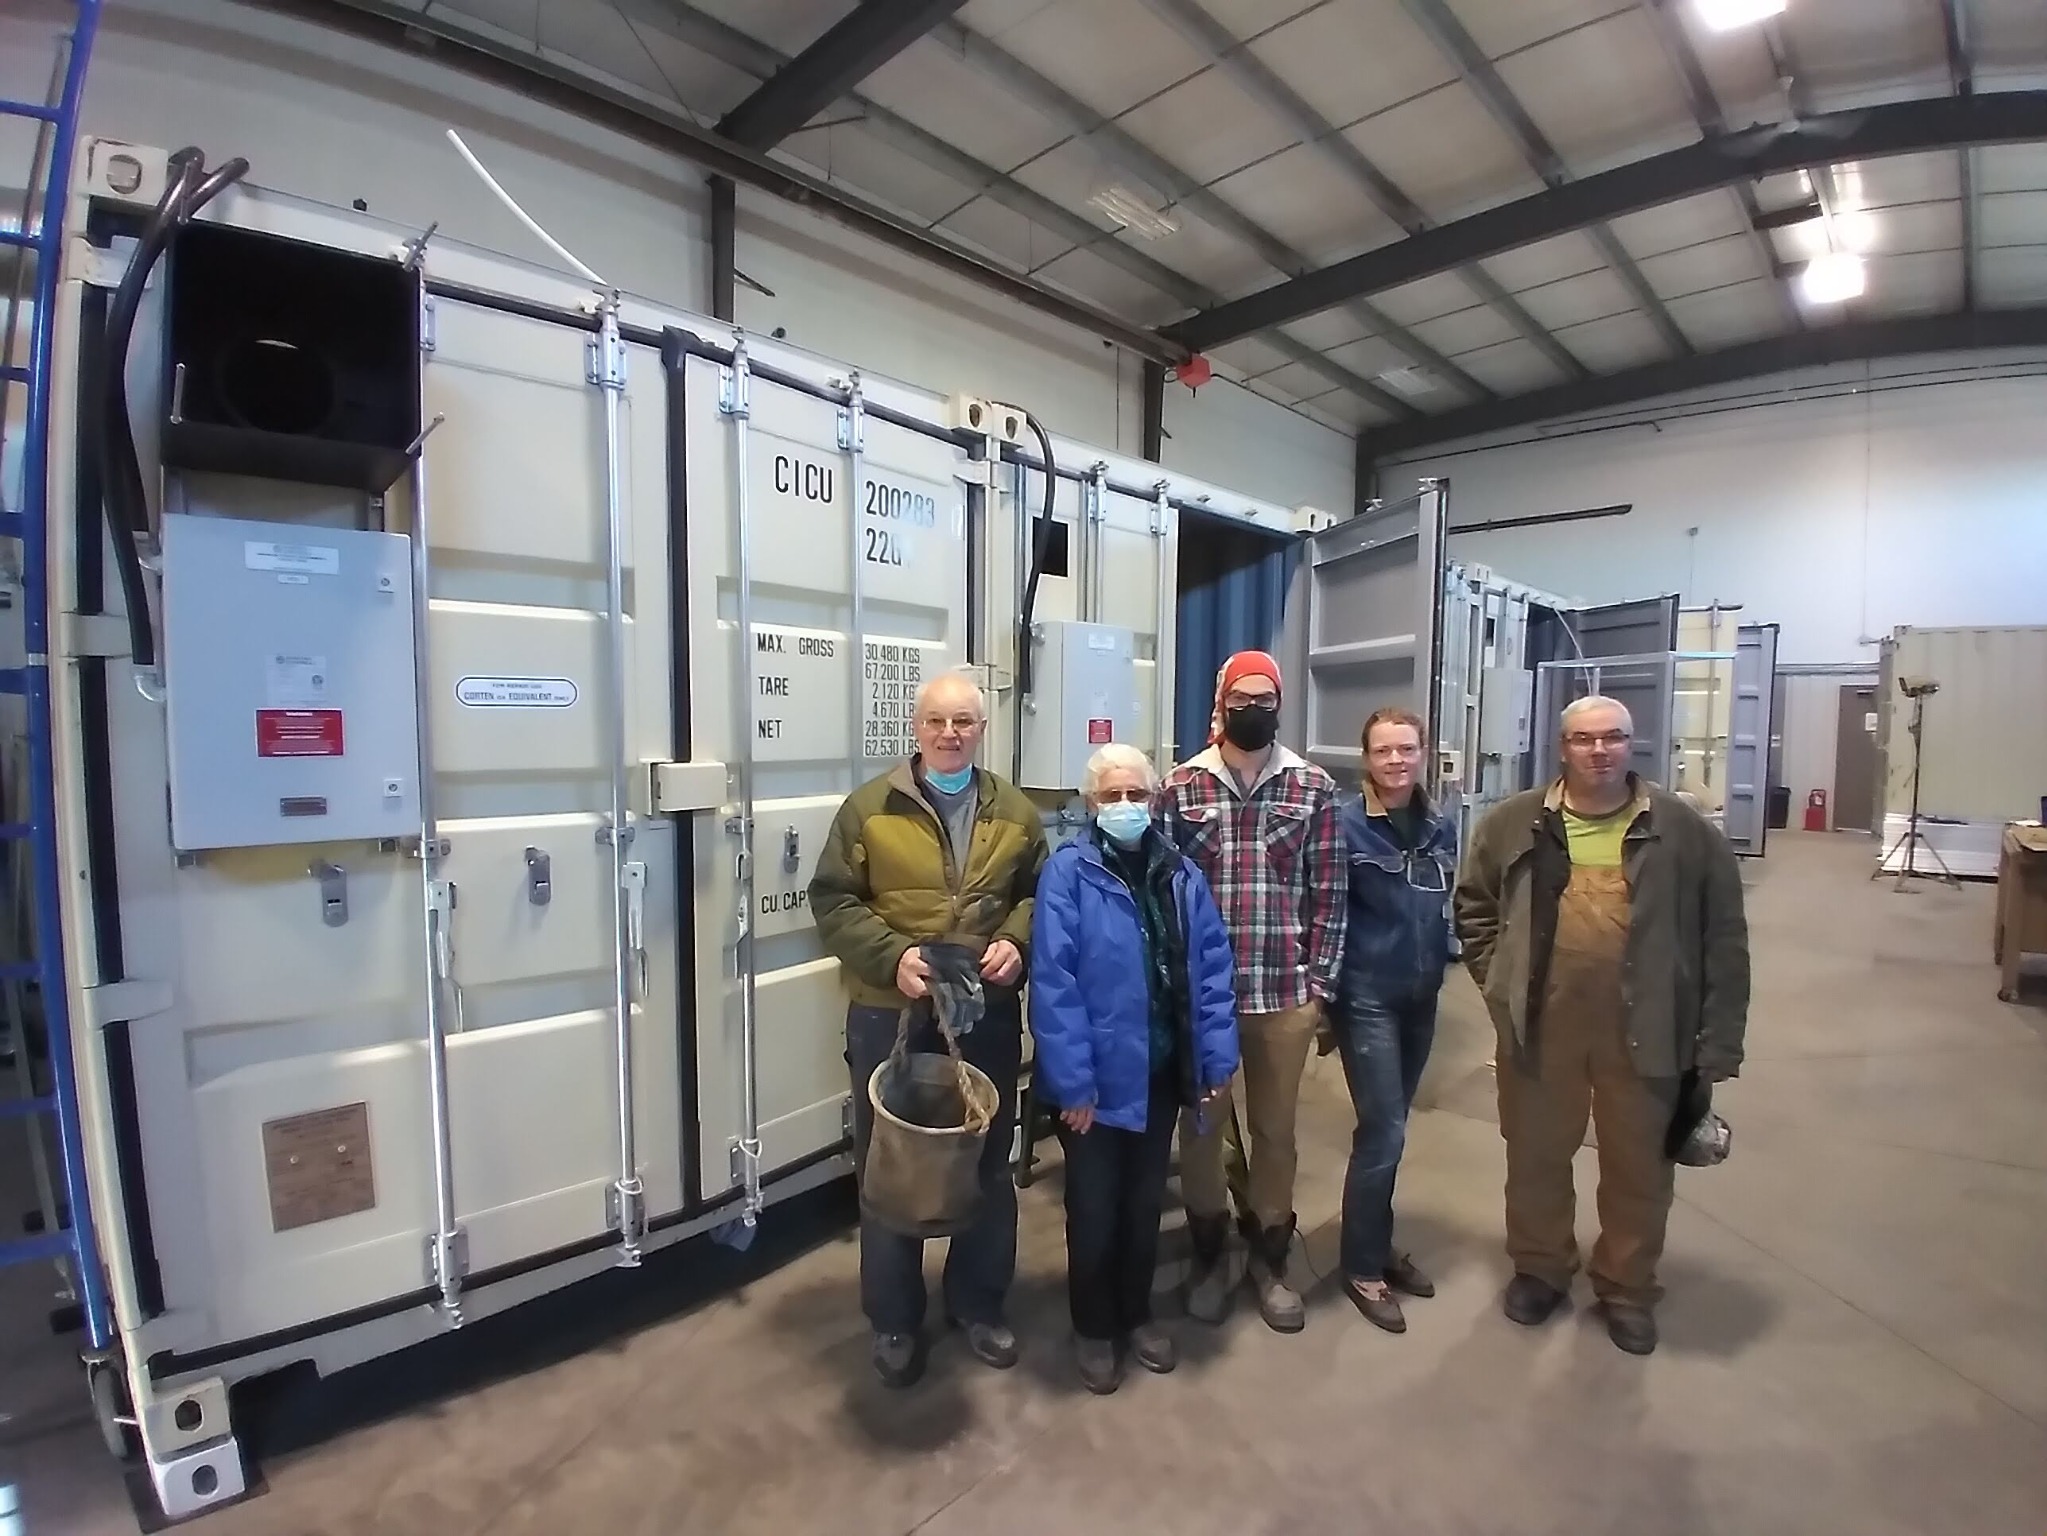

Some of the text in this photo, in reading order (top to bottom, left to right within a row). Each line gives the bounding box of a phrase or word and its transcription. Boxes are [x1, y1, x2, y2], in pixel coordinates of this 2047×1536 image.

[775, 456, 832, 503] CICU
[757, 633, 786, 653] MAX.
[799, 637, 834, 657] GROSS
[464, 692, 494, 701] CORTEN
[508, 693, 552, 701] EQUIVALENT
[758, 676, 789, 696] TARE
[902, 683, 918, 700] KG
[902, 702, 915, 719] LB
[758, 720, 782, 739] NET
[902, 721, 915, 738] KG
